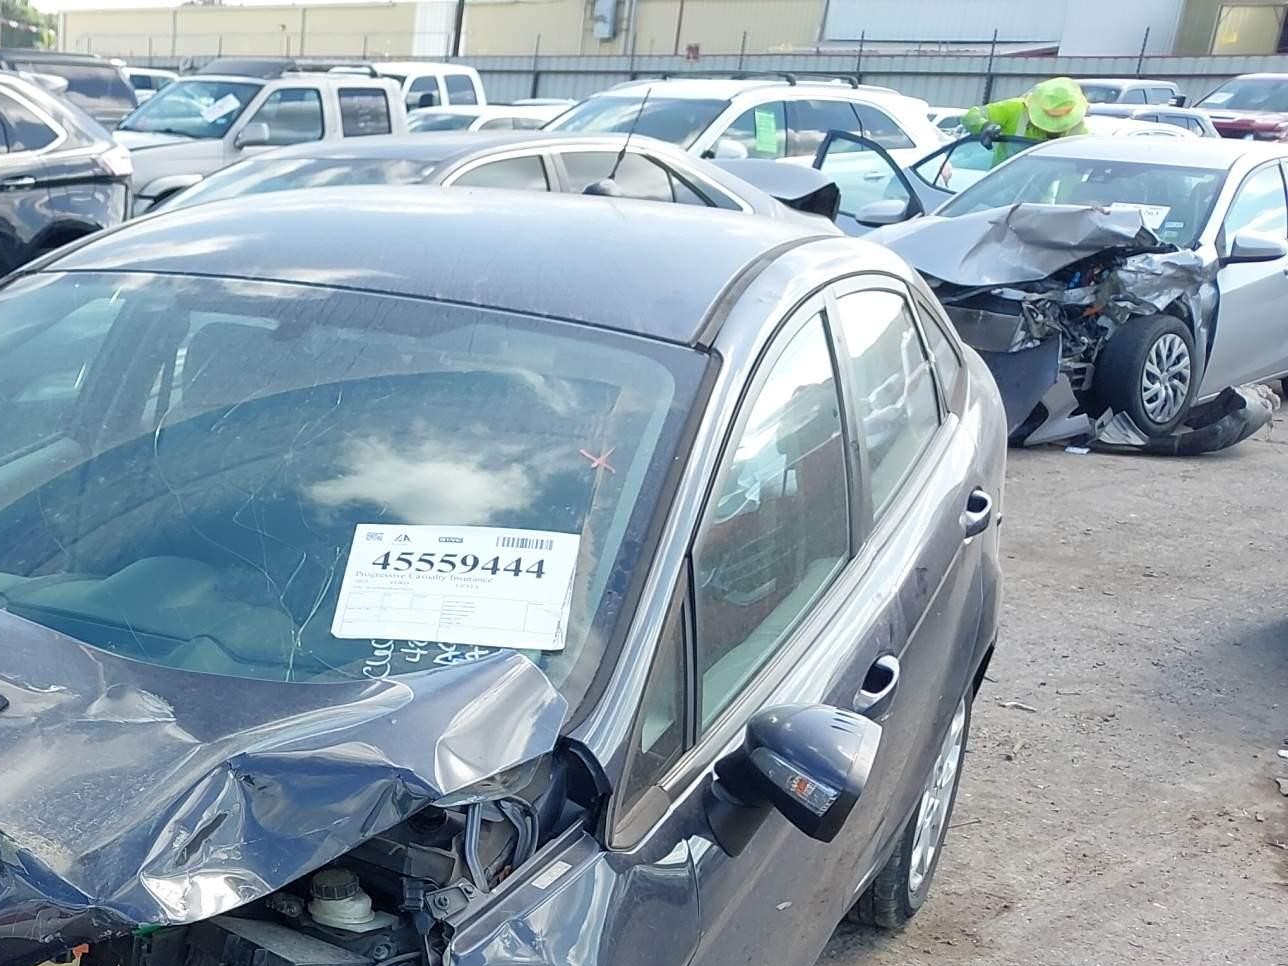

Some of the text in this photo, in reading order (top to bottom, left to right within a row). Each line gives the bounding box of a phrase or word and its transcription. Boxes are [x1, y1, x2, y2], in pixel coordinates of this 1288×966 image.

[372, 551, 546, 579] 45559444
[355, 571, 494, 583] Progressive Casualty Insurance
